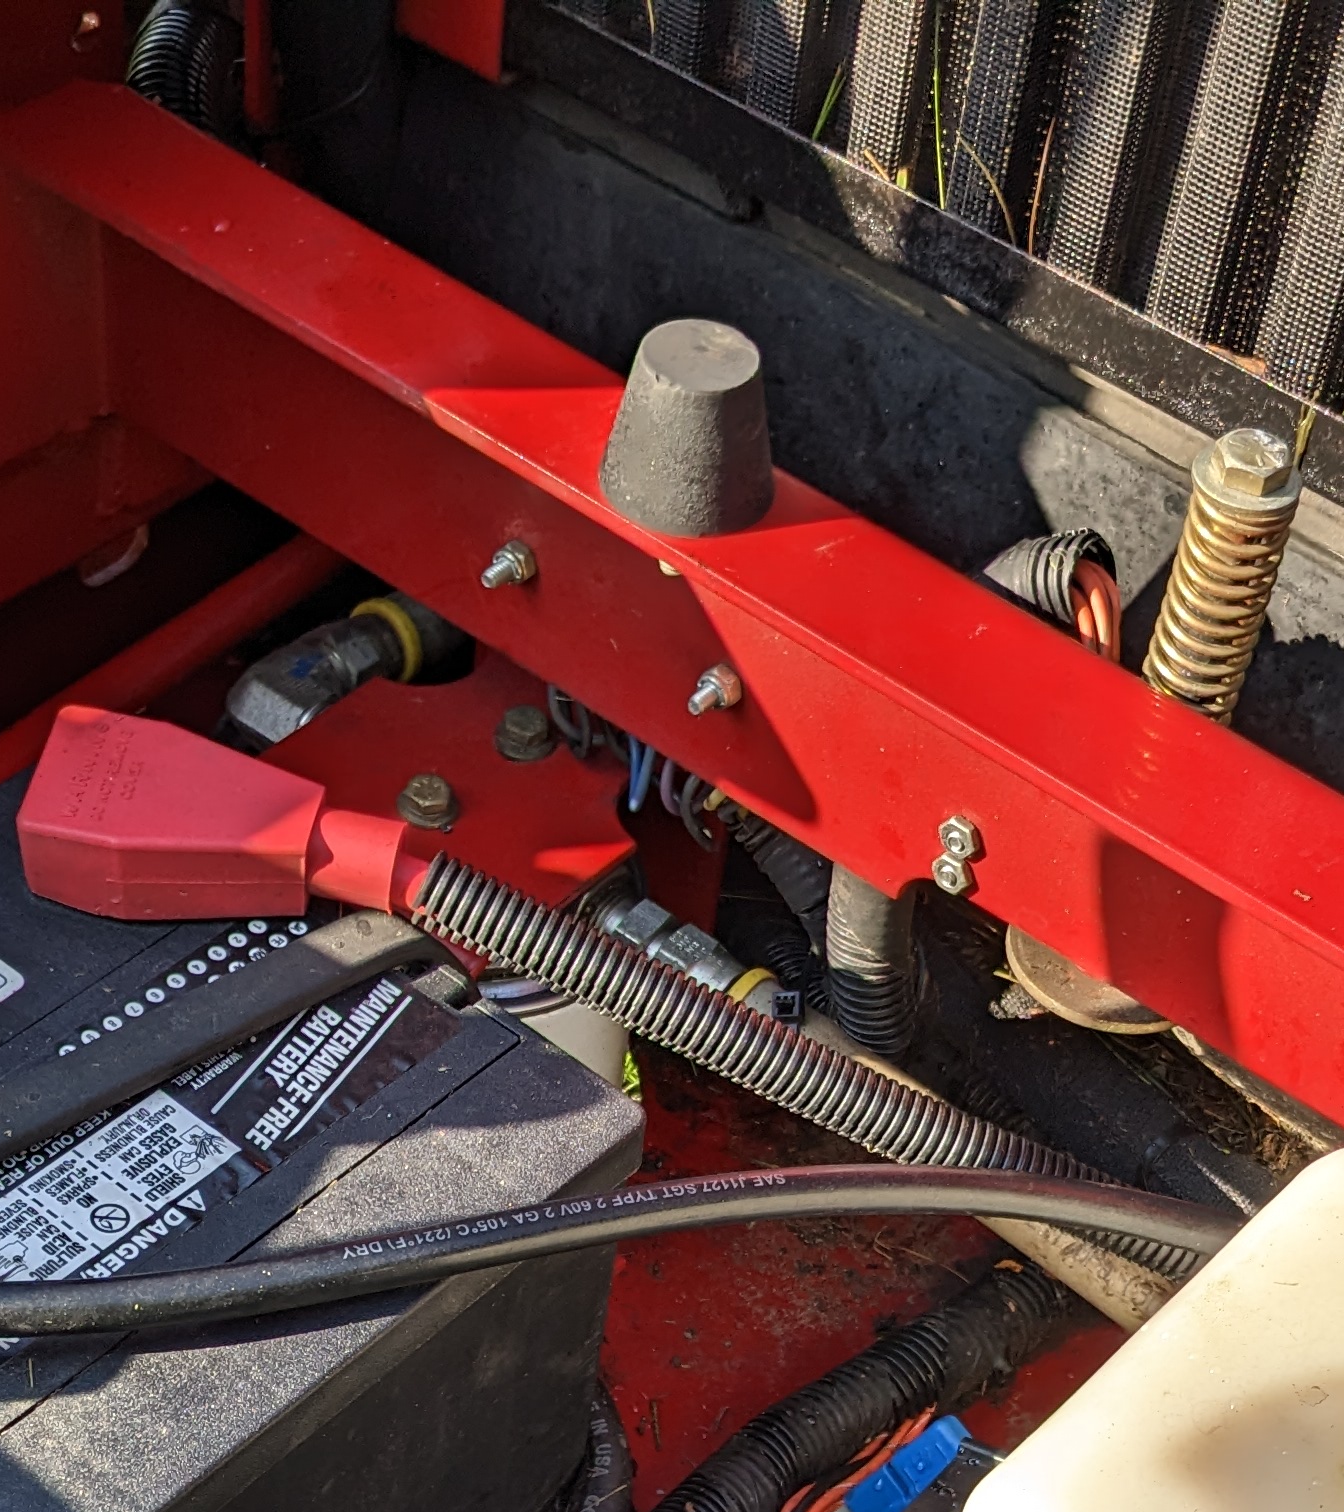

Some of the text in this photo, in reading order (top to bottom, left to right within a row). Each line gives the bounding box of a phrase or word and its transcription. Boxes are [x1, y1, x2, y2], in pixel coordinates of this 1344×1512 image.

[263, 1004, 343, 1088] BATTERY
[169, 1064, 203, 1087] LABEL
[244, 978, 403, 1151] MAINTENANCE-FREE
[74, 1108, 112, 1138] KEEP
[92, 1103, 177, 1163] CAUSE BLINDNESS
[43, 1133, 75, 1158] OUT
[117, 1121, 177, 1164] GASES CAN
[24, 1153, 45, 1173] OF
[119, 1134, 183, 1181] EXPLOSIVE
[135, 1162, 174, 1187] EYES.
[702, 1176, 746, 1192] J1127
[749, 1173, 786, 1186] SAE
[143, 1171, 186, 1202] SHIELD
[661, 1183, 698, 1198] SGT
[75, 1191, 99, 1209] NO
[559, 1200, 591, 1216] 60V
[593, 1197, 606, 1208] 2
[510, 1209, 539, 1222] GA
[542, 1206, 555, 1219] 2
[12, 1214, 50, 1242] CAUSE
[35, 1223, 61, 1242] CAN
[386, 1226, 451, 1250] (221°F)
[455, 1217, 507, 1236] 105°C
[40, 1230, 73, 1256] ACID
[341, 1240, 382, 1260] DRY
[27, 1240, 87, 1284] SULFURIC
